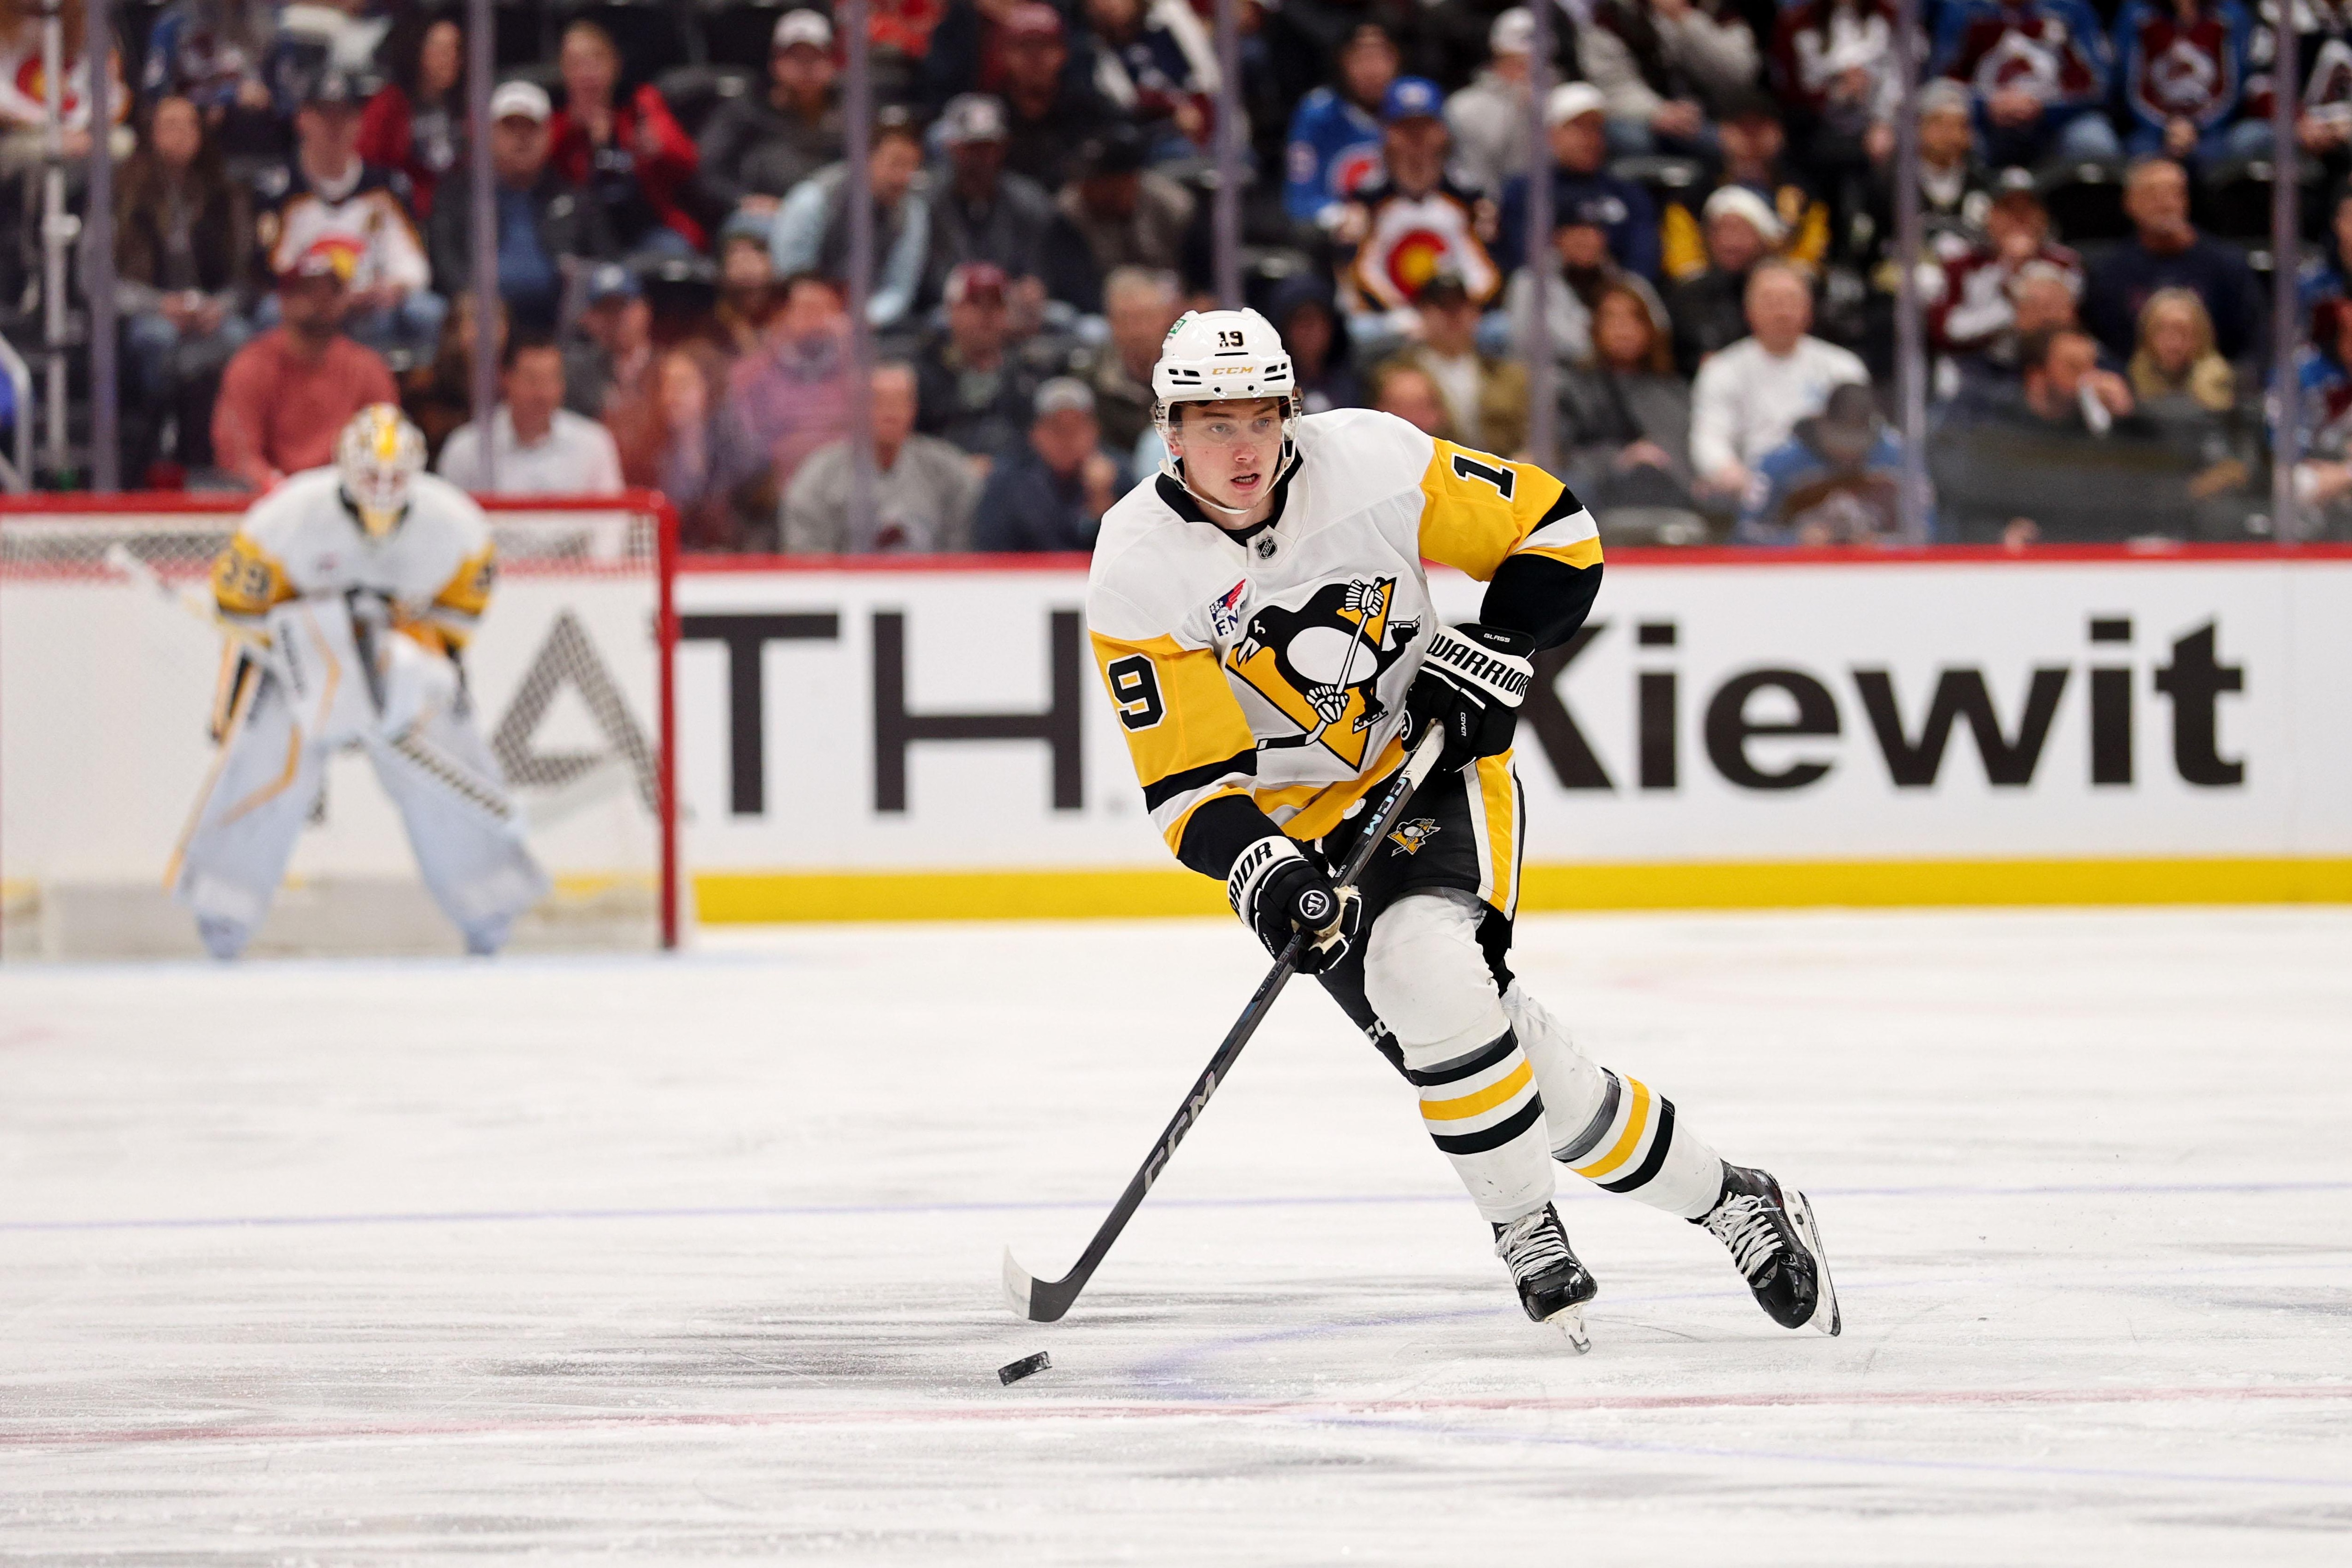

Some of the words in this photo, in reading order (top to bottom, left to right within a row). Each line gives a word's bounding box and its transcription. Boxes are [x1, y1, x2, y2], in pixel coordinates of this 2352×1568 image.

[1217, 331, 1244, 347] 19
[1212, 366, 1254, 375] CCM
[1263, 541, 1272, 557] NHL
[1484, 633, 1510, 643] GLASS
[1426, 633, 1530, 697] WARRIOR
[1518, 617, 2244, 789] Kiewit
[1363, 778, 1407, 836] CCM
[1144, 1071, 1216, 1194] CCM
